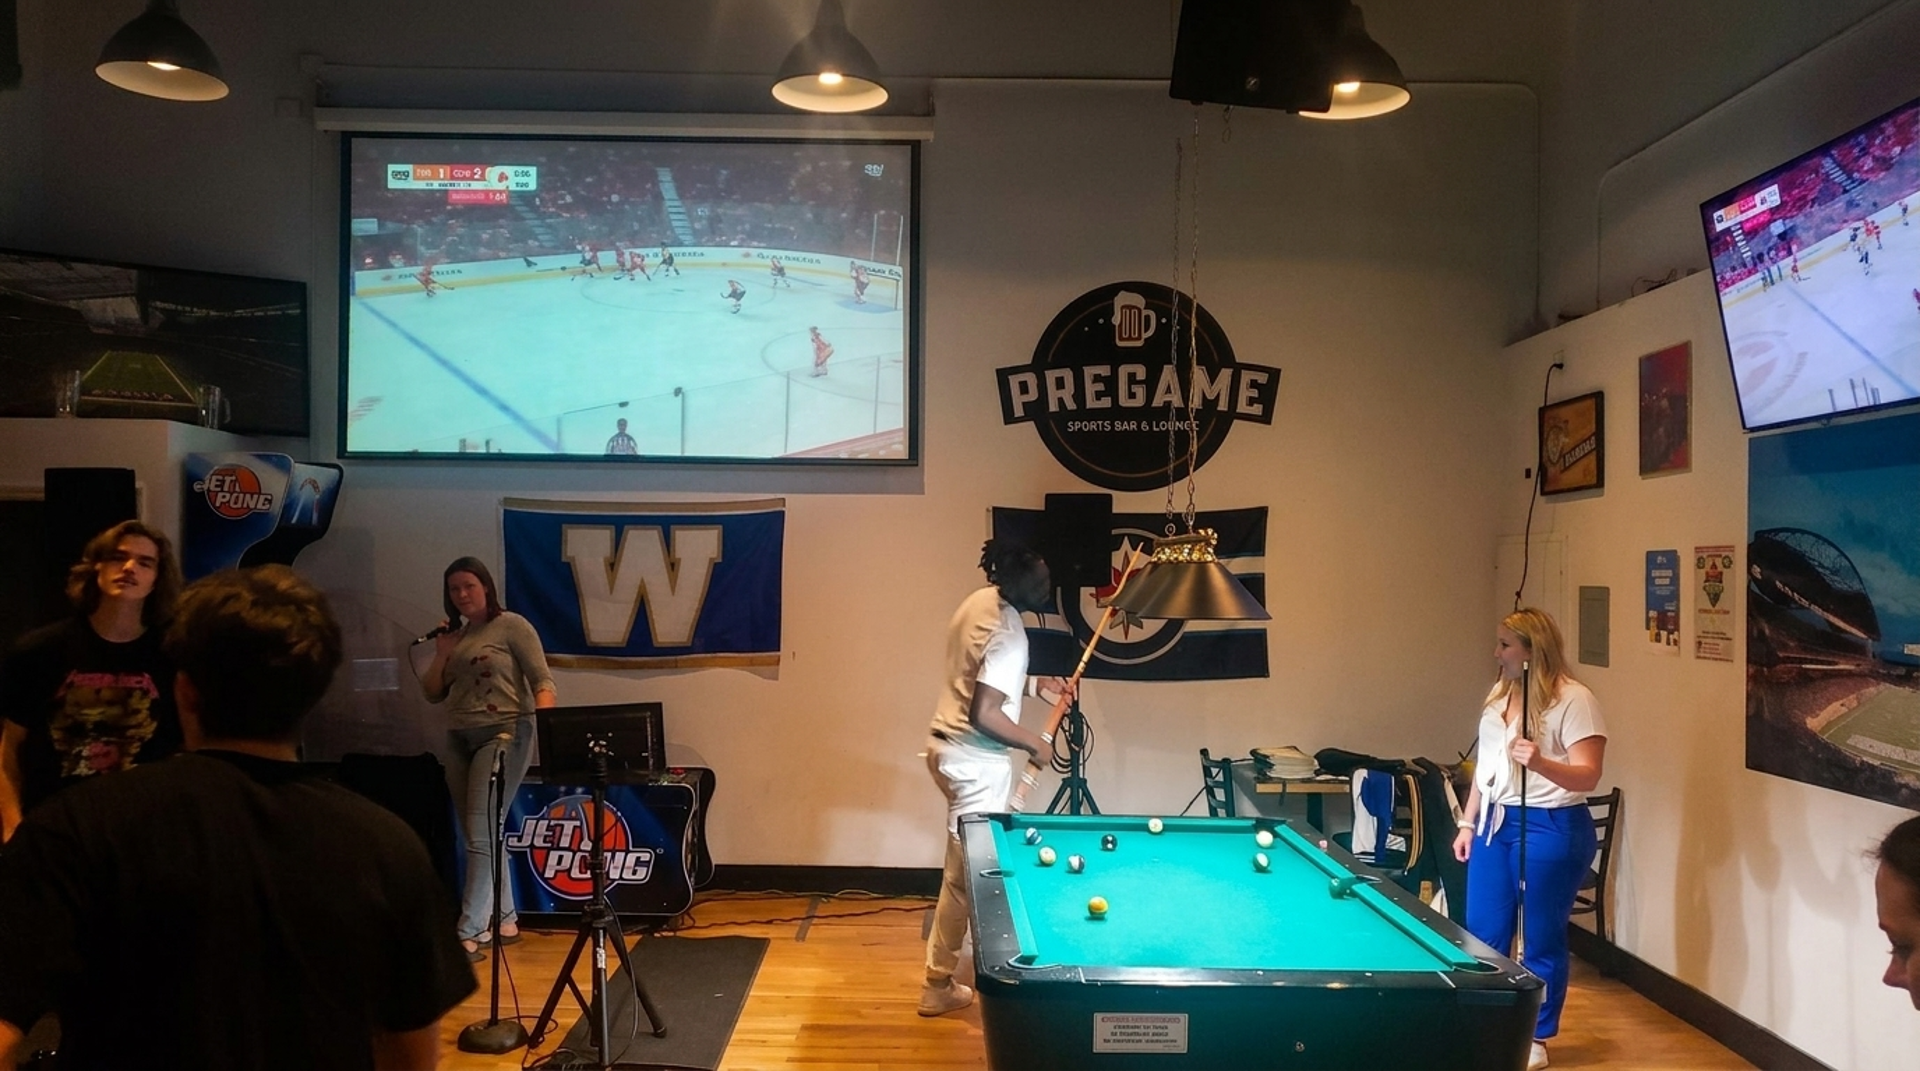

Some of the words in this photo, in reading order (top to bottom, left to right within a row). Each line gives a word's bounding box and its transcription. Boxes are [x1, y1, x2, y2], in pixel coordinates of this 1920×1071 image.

[473, 168, 481, 180] 2
[1008, 364, 1269, 417] PREGAME
[1067, 421, 1112, 432] SPORTS
[1114, 421, 1138, 432] BAR
[561, 524, 724, 648] W
[508, 819, 581, 848] JET
